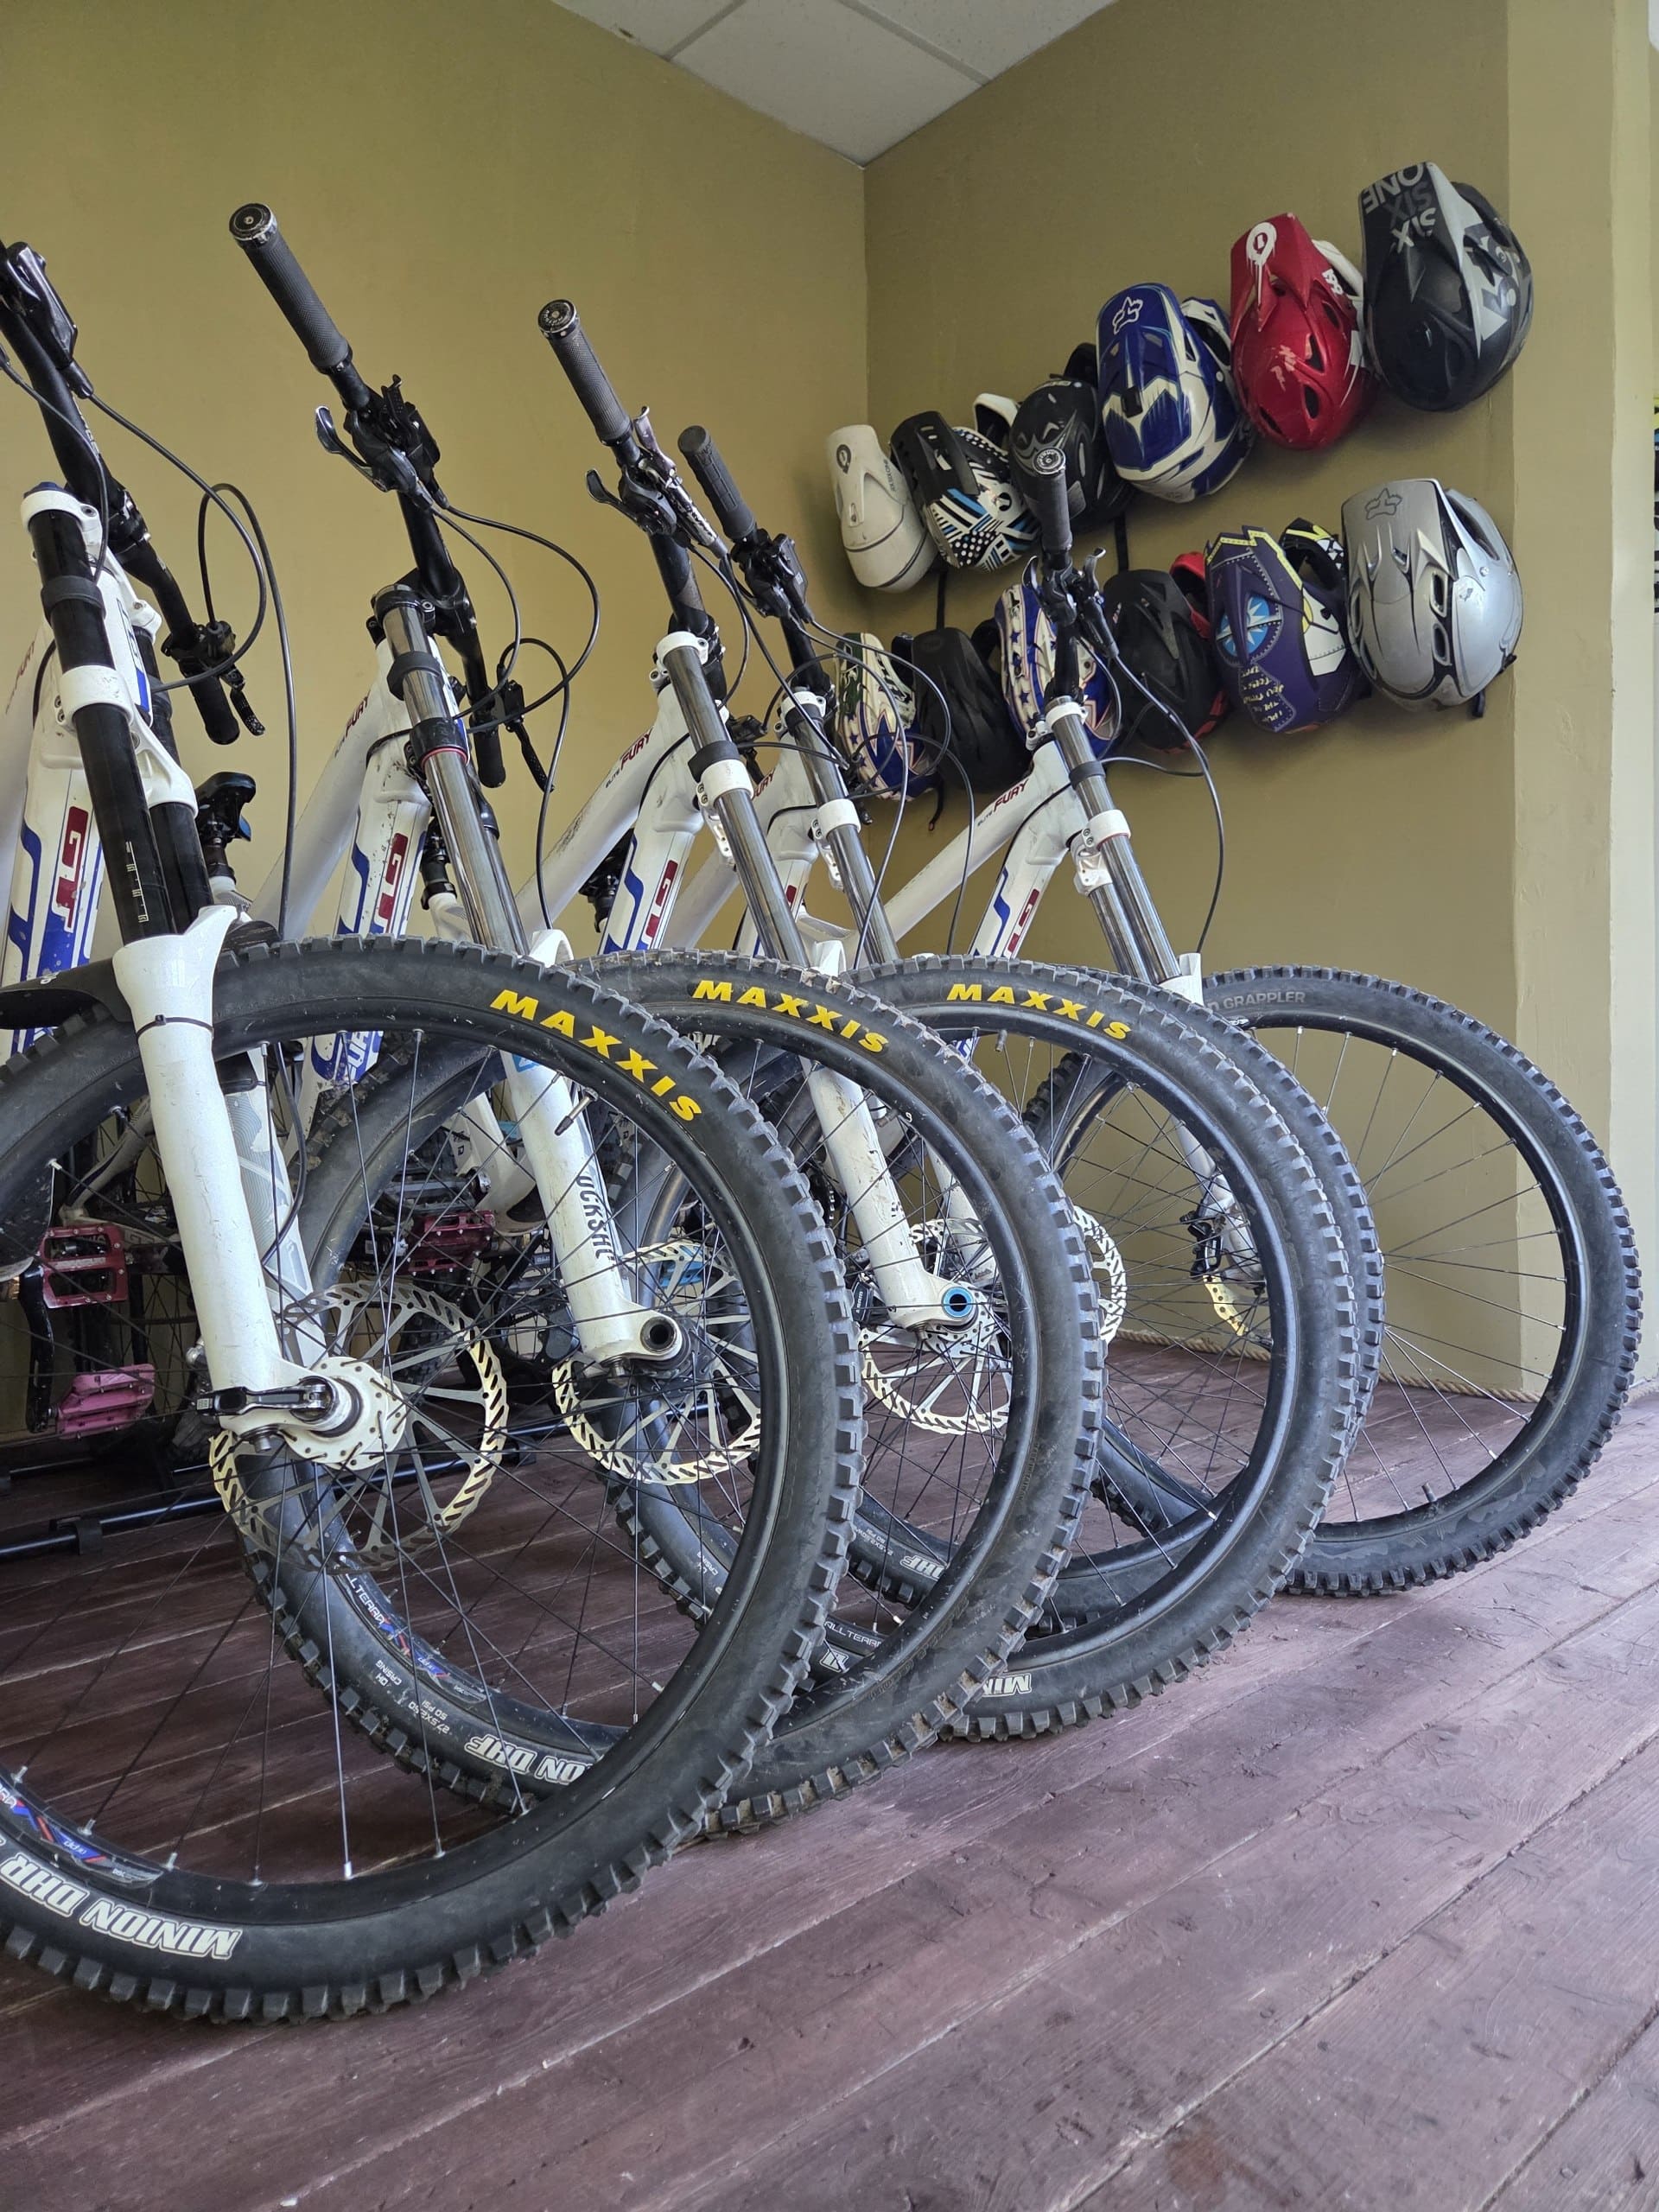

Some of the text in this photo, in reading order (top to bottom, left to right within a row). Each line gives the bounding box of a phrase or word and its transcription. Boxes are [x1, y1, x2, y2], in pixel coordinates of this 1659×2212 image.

[620, 728, 654, 771] FURY
[993, 778, 1029, 813] FURY
[54, 804, 90, 933] GT
[692, 980, 889, 1053] MAXXIS
[946, 983, 1132, 1040] MAXXIS
[1223, 991, 1306, 1009] GRAPPLER
[489, 988, 702, 1122] MAXXIS
[375, 1659, 403, 1686] CASING
[375, 1672, 389, 1687] DH
[421, 1699, 448, 1721] 50 PSI
[463, 1733, 537, 1775] DHF
[0, 1852, 243, 1961] MINION DHR
